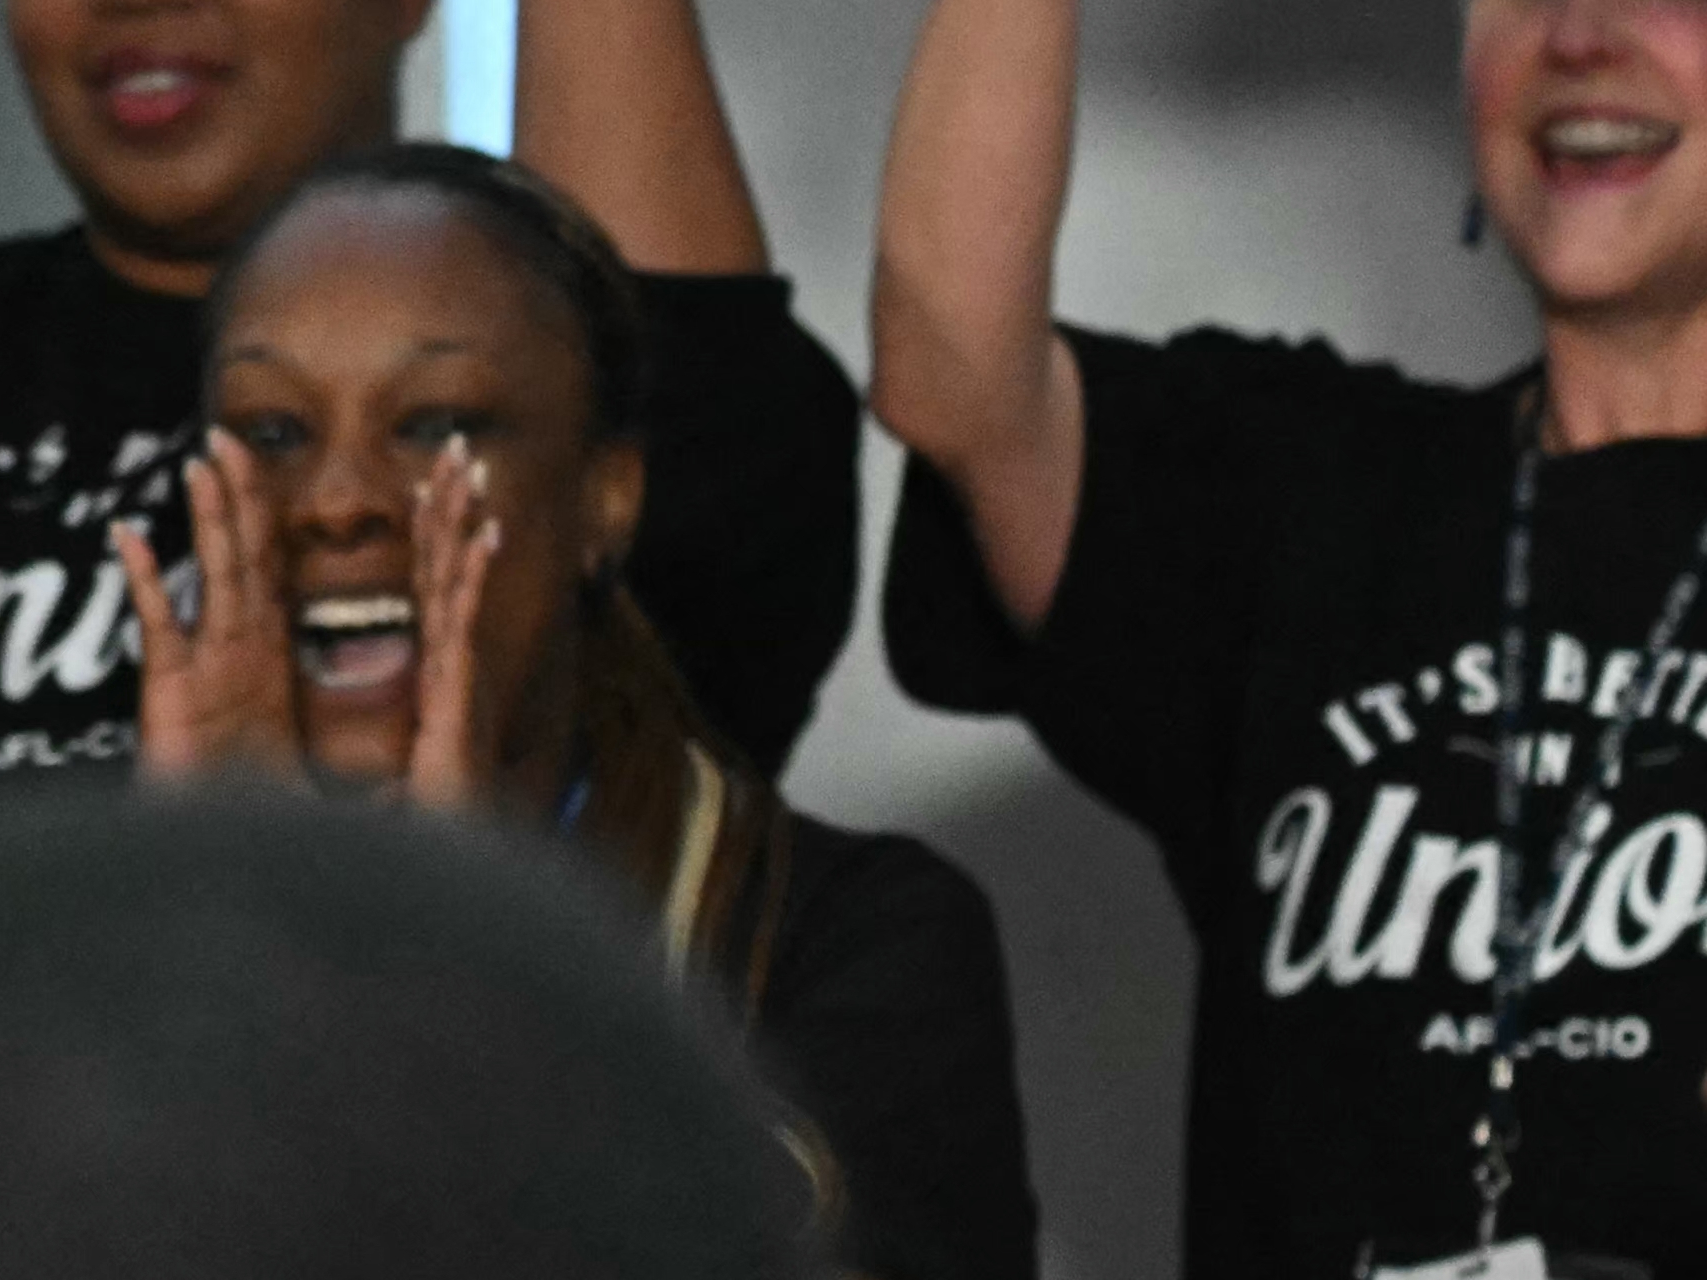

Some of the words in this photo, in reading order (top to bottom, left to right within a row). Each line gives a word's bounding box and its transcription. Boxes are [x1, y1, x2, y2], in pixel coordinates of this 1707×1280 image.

[1320, 641, 1502, 768] IT'S
[1255, 782, 1707, 998] Unio
[1419, 1012, 1651, 1061] AF-CIO
